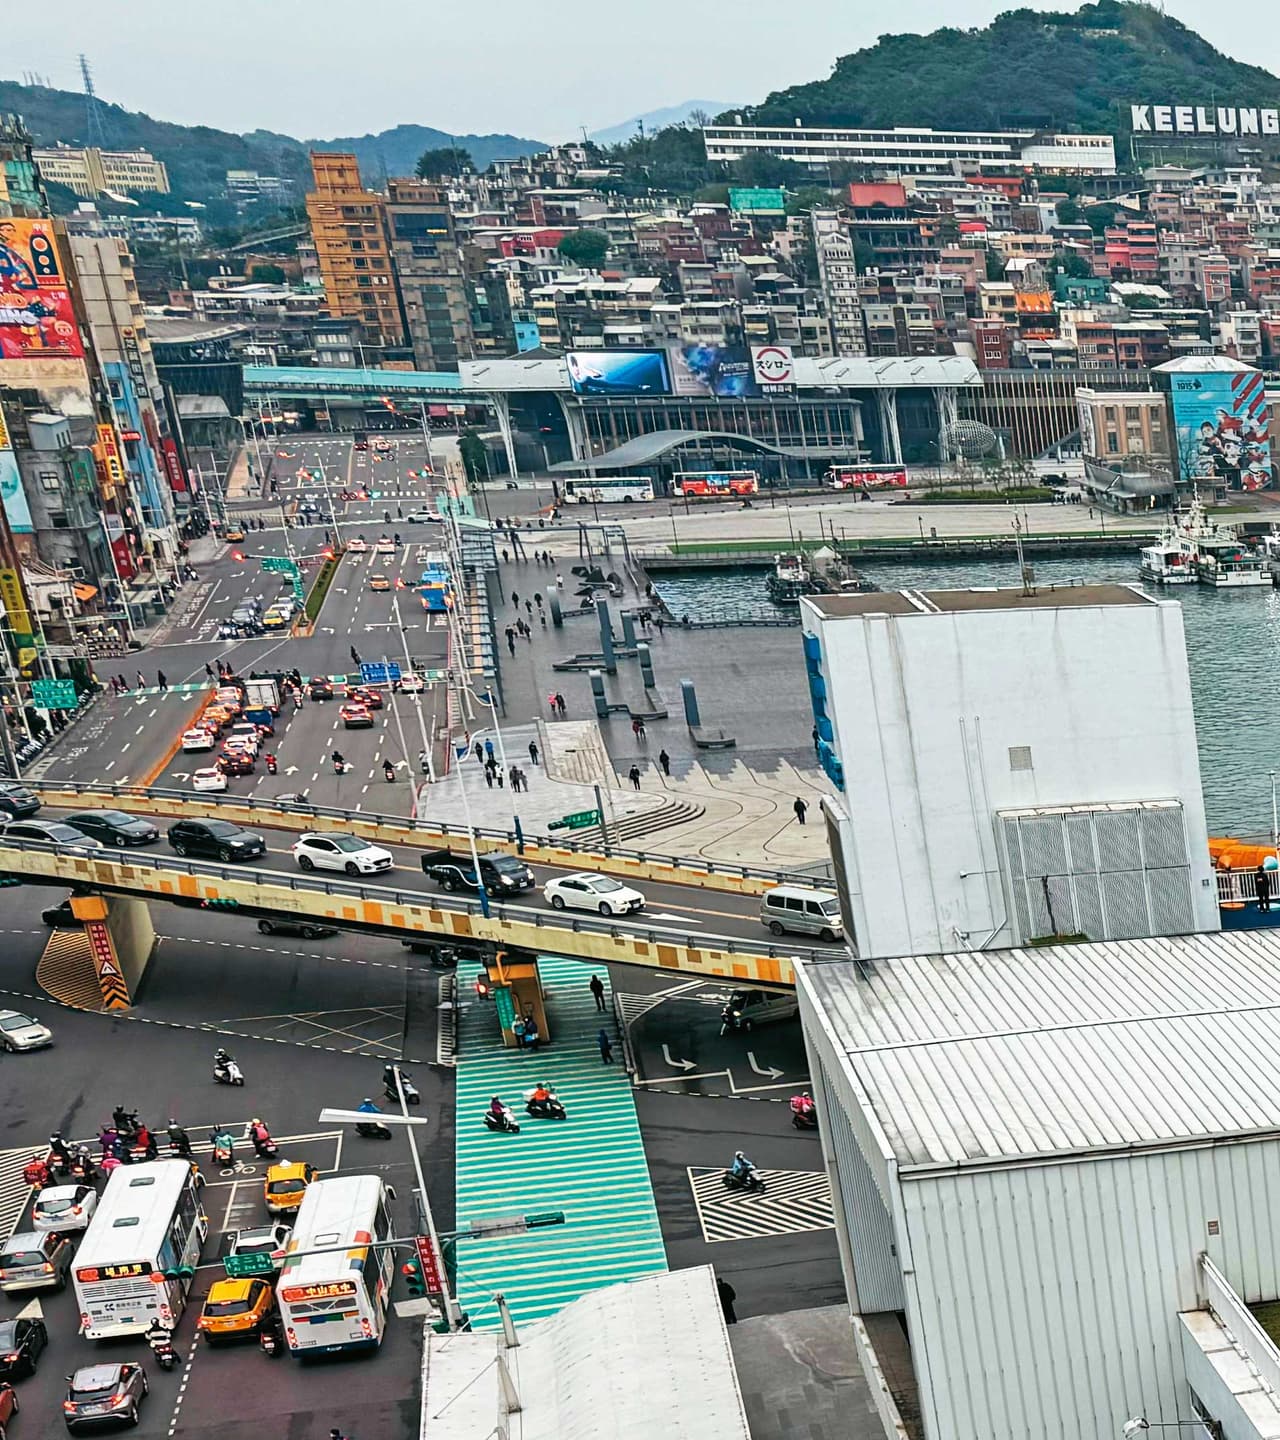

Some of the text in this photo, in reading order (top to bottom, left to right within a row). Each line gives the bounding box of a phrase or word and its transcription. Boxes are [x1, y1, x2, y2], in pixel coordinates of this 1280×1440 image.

[1130, 104, 1280, 136] KEELUNG
[756, 360, 792, 370] スシロー
